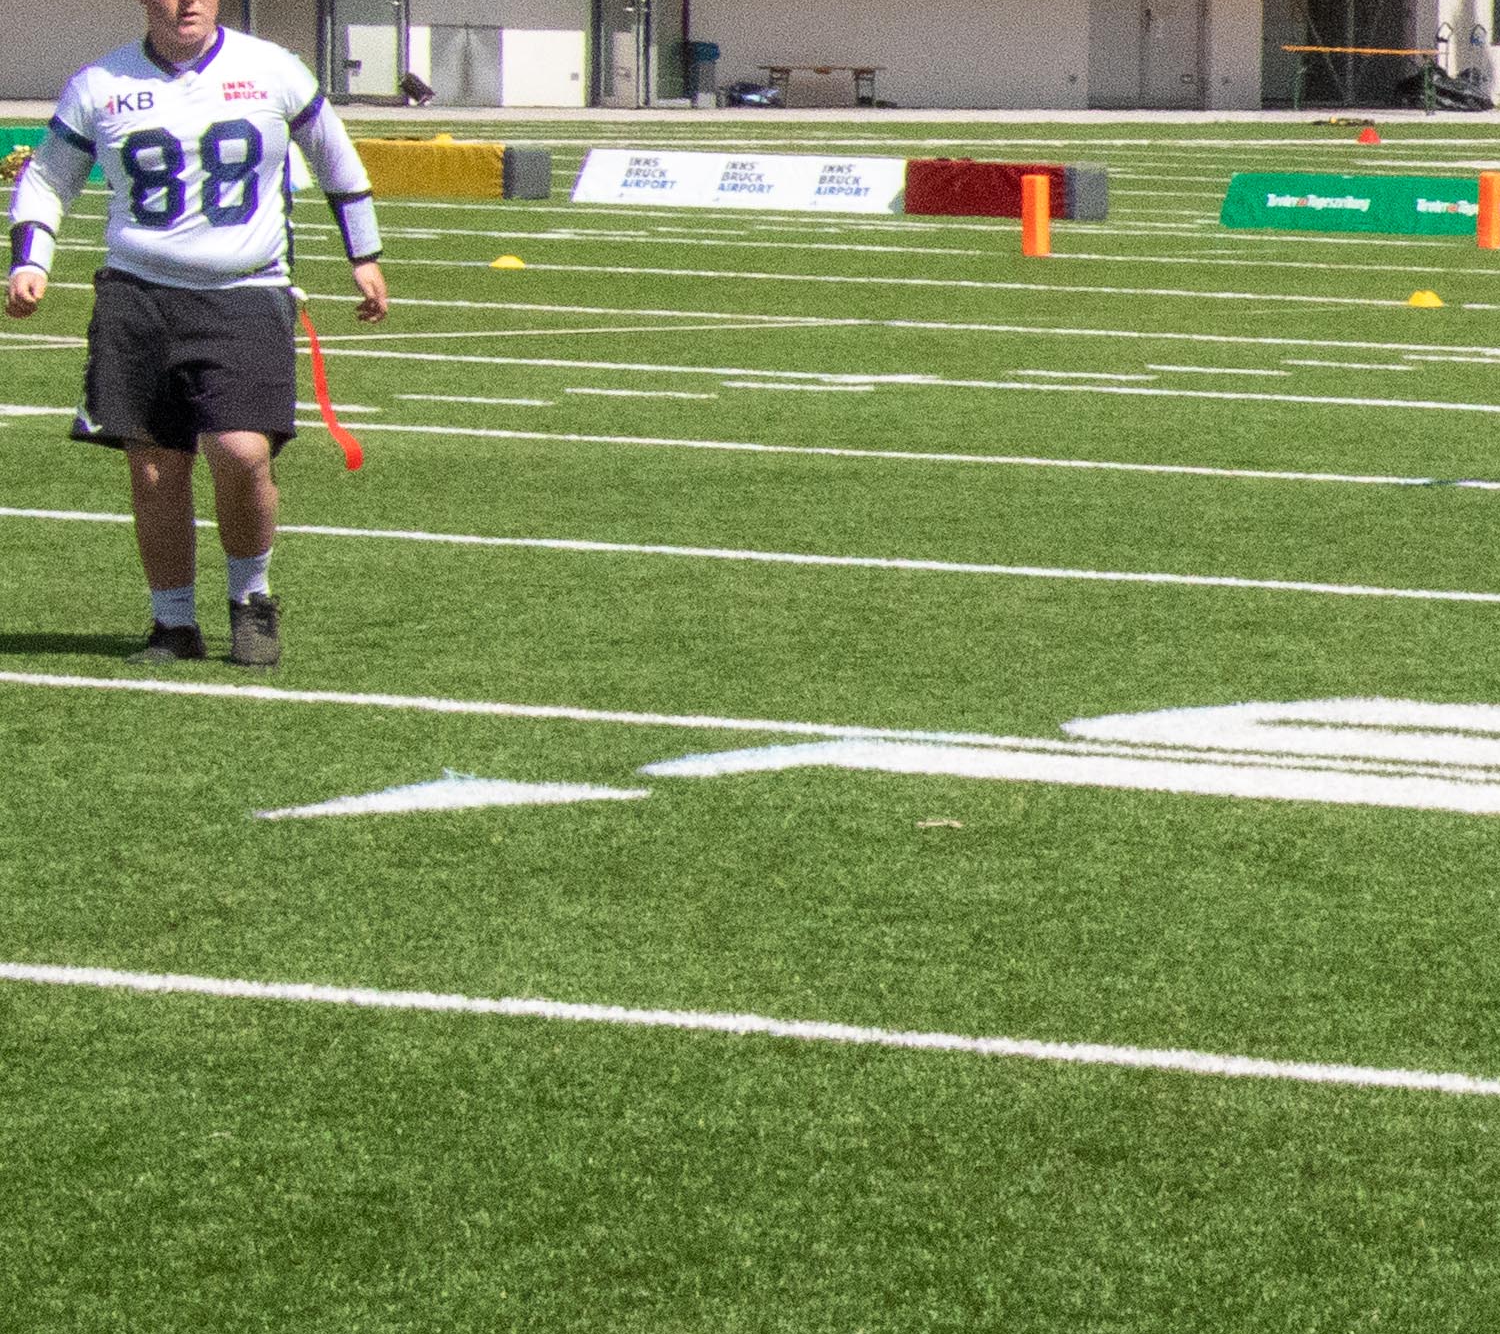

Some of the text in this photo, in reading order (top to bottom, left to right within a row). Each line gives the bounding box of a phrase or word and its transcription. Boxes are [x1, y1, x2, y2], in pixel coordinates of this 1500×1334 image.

[223, 90, 269, 101] BRUCK
[105, 91, 154, 115] iKB
[120, 118, 263, 231] 88
[625, 167, 668, 179] BRUCK
[721, 171, 764, 183] BRUCK
[620, 178, 677, 190] AIRPORT
[818, 174, 861, 186] BRUCK
[717, 182, 775, 195] AIRPORT
[814, 185, 871, 197] AIRPORT
